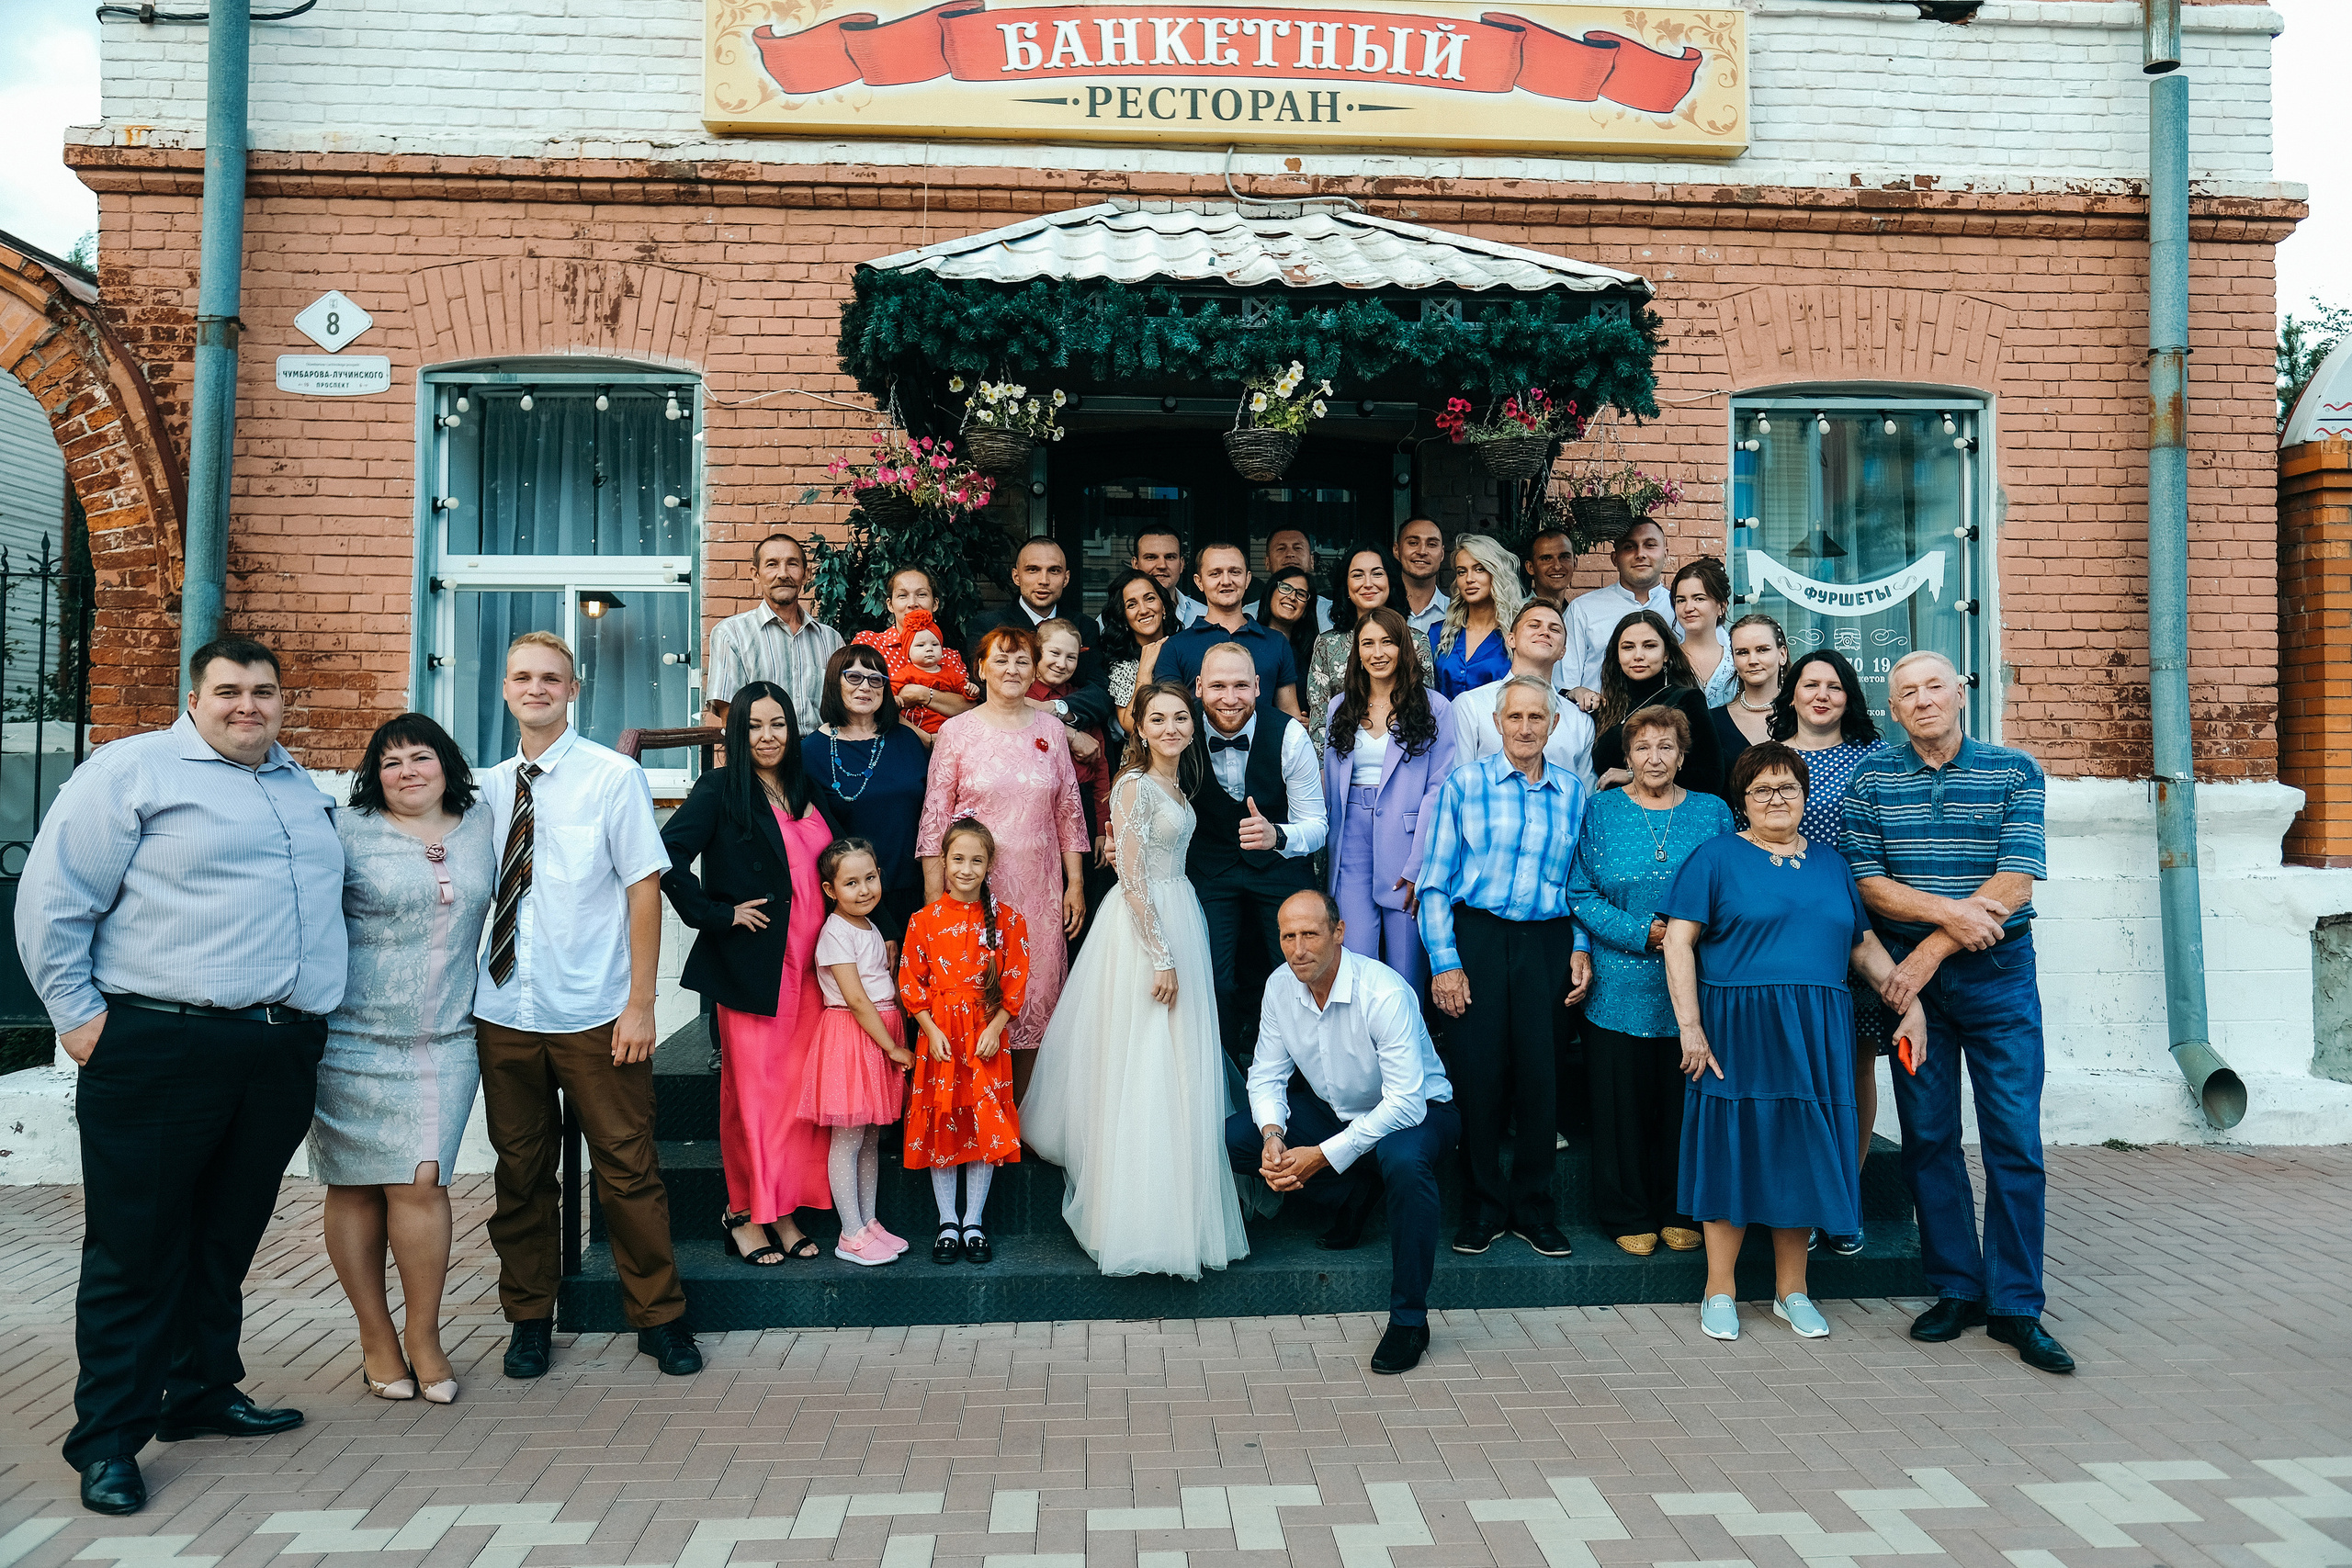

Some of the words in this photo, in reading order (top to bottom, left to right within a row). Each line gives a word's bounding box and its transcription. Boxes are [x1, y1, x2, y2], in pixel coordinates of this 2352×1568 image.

[996, 17, 1470, 82] БАНКЕТНЫЙ
[1085, 85, 1341, 123] РЕСТОРАН
[326, 311, 340, 335] 8
[282, 370, 384, 379] ЧУМБАРОВА-ЛУЧИНСКОГО
[1804, 585, 1893, 606] ФУРШЕТЫ
[1872, 657, 1891, 673] 19
